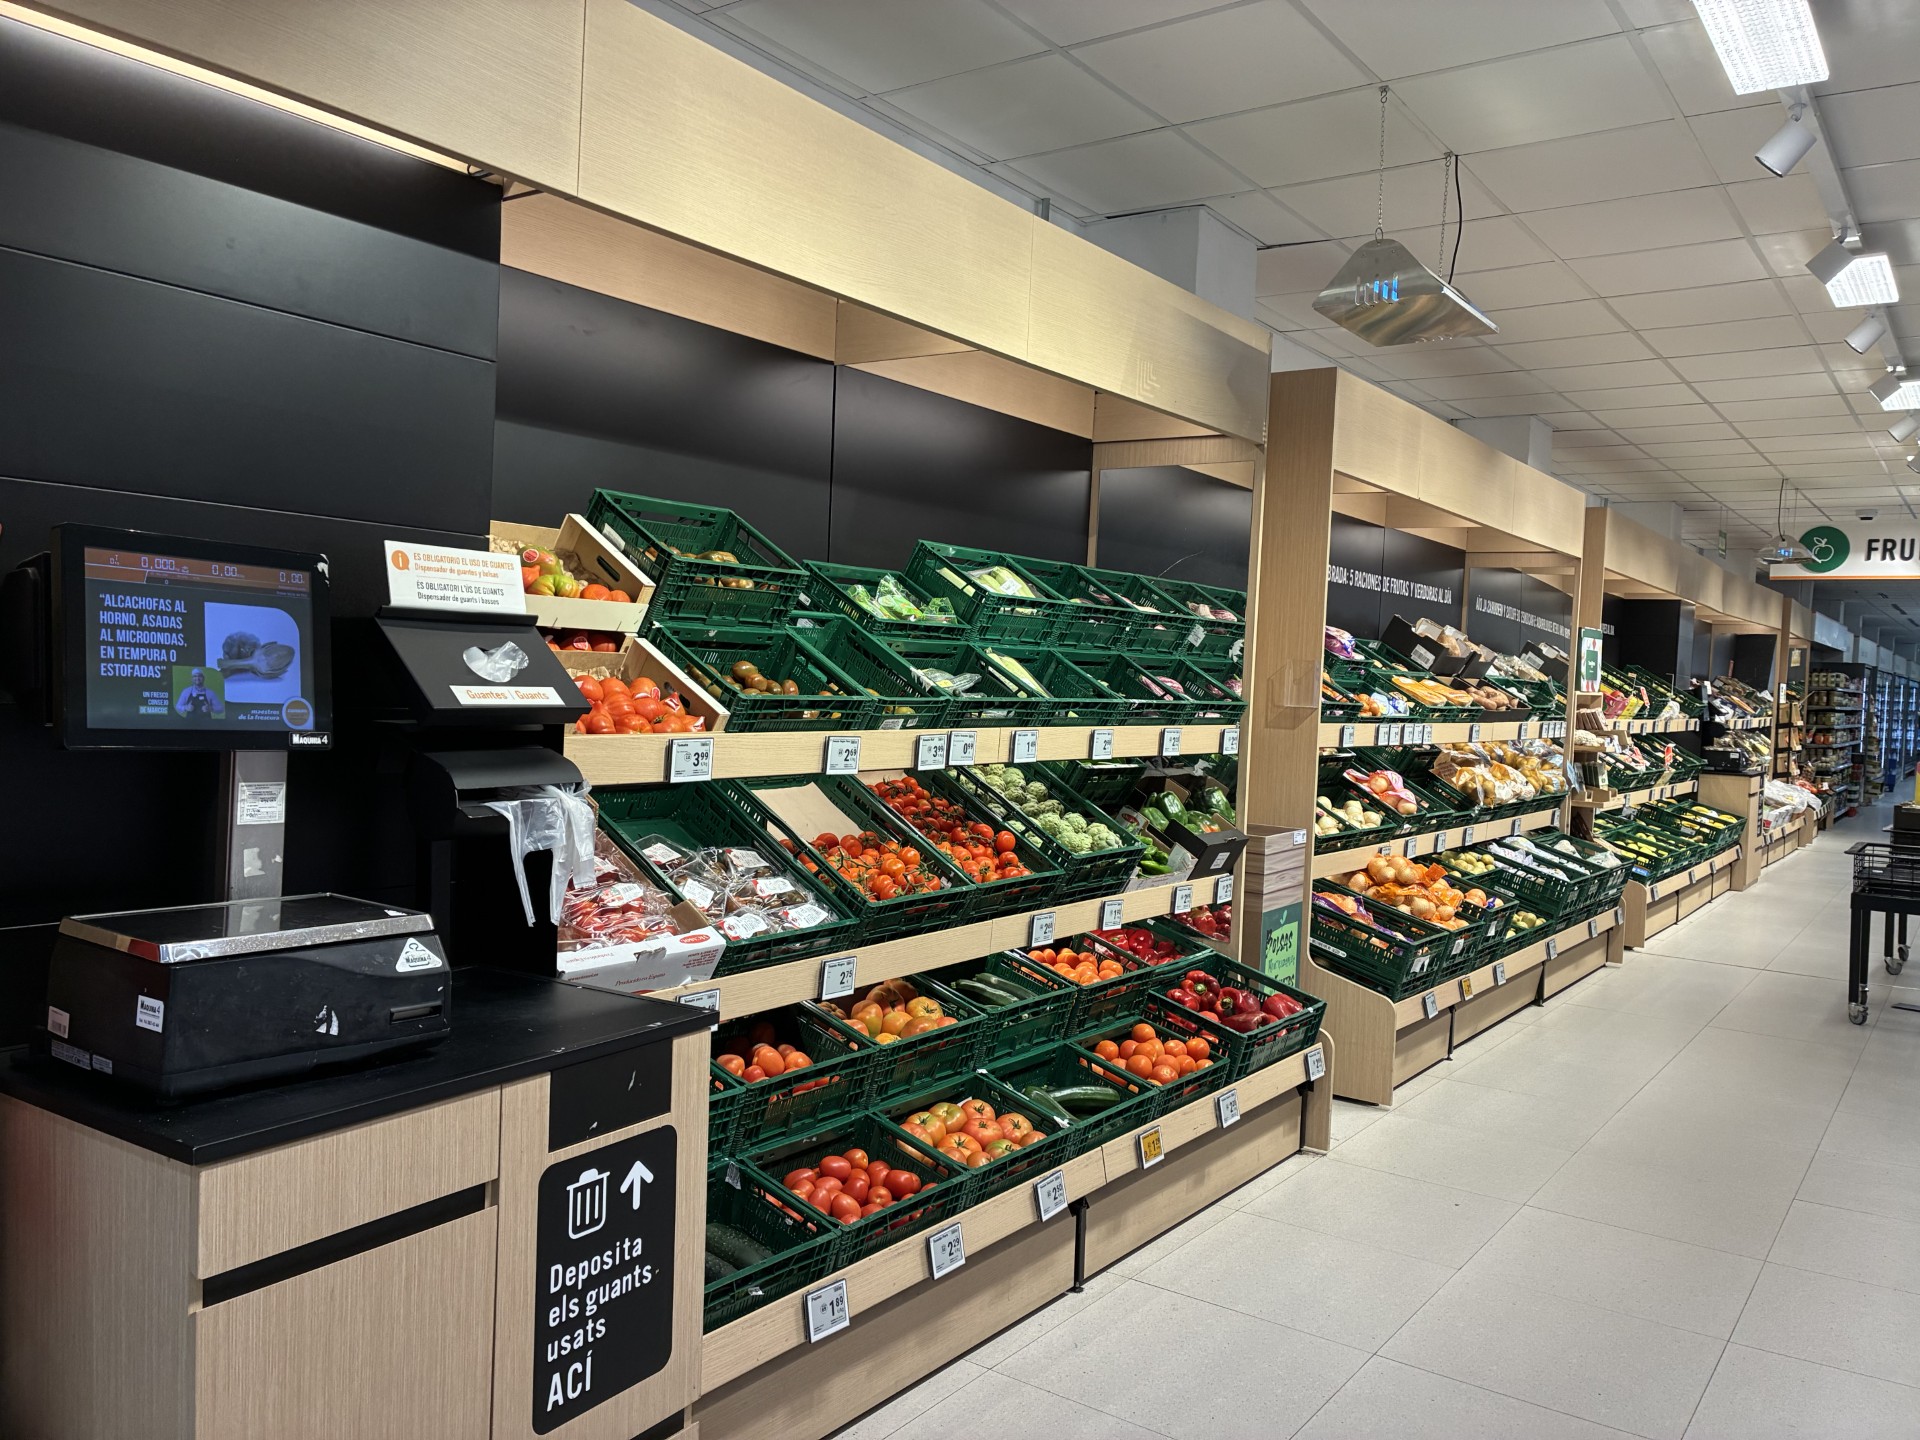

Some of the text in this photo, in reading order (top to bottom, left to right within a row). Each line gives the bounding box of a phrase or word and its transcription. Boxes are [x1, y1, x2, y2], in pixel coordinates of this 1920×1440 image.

[1865, 538, 1920, 561] FRU
[141, 557, 175, 571] 0,000
[413, 552, 514, 570] ES OBLIGATORIO EL USO DE GUANTES
[212, 564, 238, 577] 0,00
[280, 572, 304, 584] 0,00
[414, 563, 448, 574] Dispensador
[449, 566, 456, 574] de
[456, 568, 478, 578] guantes
[483, 570, 498, 578] bolsas
[426, 582, 460, 593] OBLIGATORI
[474, 586, 482, 594] DE
[482, 587, 504, 596] GUANTS
[1350, 569, 1354, 586] 5
[1354, 570, 1382, 591] RACIONES
[1382, 576, 1390, 592] DE
[1390, 578, 1409, 596] FRUTAS
[1410, 582, 1414, 597] Y
[1414, 583, 1438, 602] VERDURAS
[1438, 588, 1444, 603] AL
[1444, 587, 1452, 604] DÍA
[174, 598, 187, 614] AL
[418, 592, 450, 602] Dispensador
[452, 594, 459, 602] de
[460, 596, 478, 606] guants
[482, 597, 500, 606] bosses
[100, 611, 182, 630] HORNO, ASADAS
[100, 629, 188, 648] AL MICROONDAS,
[100, 646, 177, 662] EN TEMPURA O
[148, 698, 168, 706] CONSEJO
[466, 690, 550, 700] Guantes Guants
[321, 734, 328, 744] 4
[156, 1005, 161, 1014] 4
[550, 1236, 642, 1294] Deposita
[548, 1264, 652, 1328] els guants
[548, 1318, 606, 1363] usats
[546, 1350, 592, 1412] ACÍ
